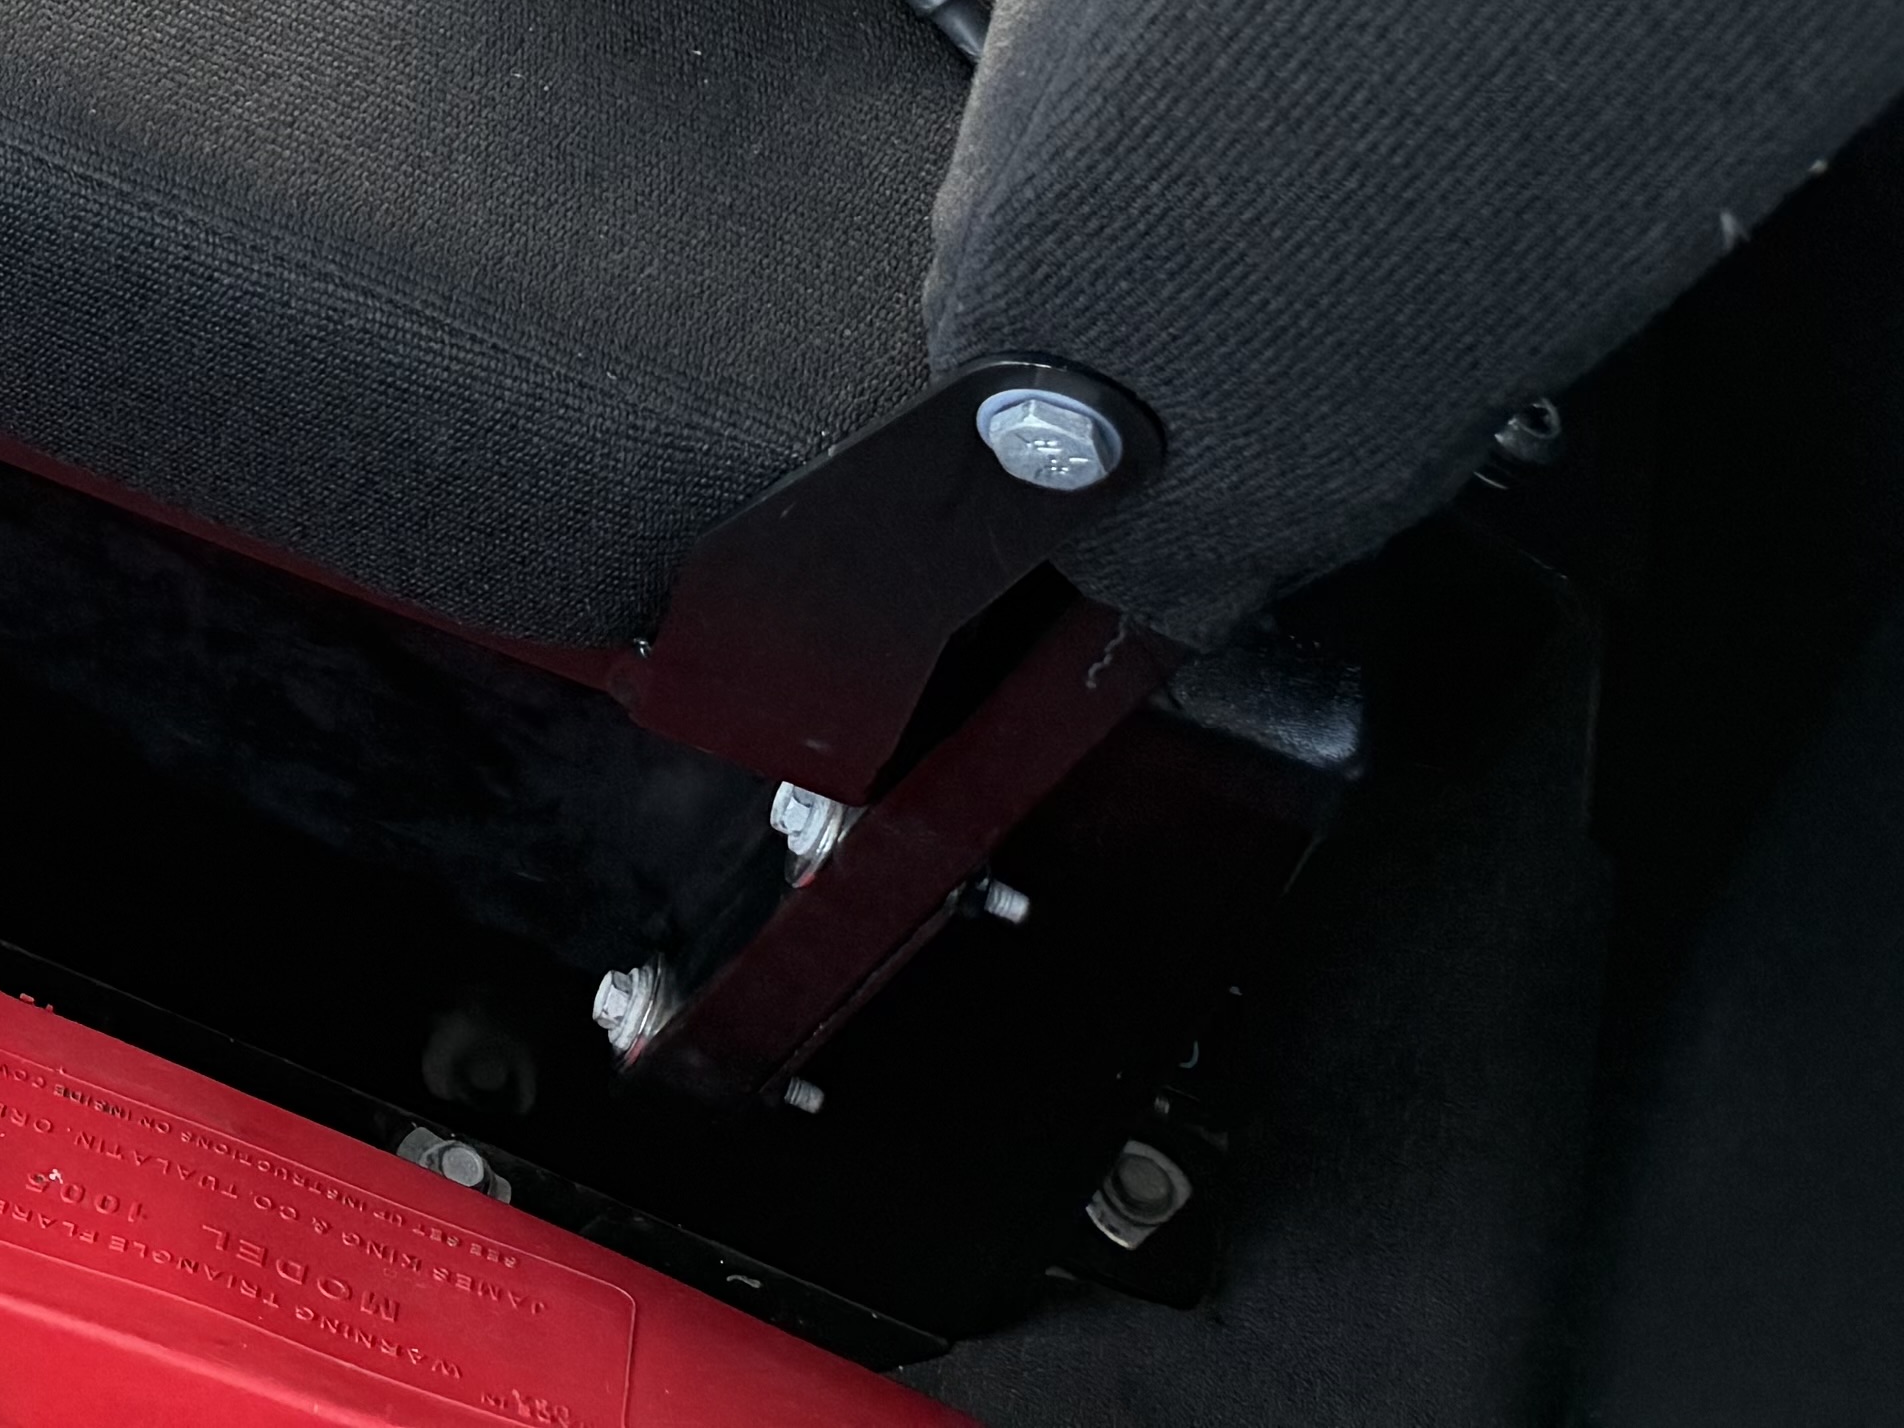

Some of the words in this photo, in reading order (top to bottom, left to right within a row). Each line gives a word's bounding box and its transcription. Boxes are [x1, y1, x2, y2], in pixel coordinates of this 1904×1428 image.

[53, 1082, 132, 1121] INSIDE
[24, 1168, 144, 1224] 1005
[180, 1130, 367, 1213] INSTRUCTIONS
[312, 1216, 333, 1235] &
[341, 1230, 422, 1272] KING
[412, 1222, 461, 1248] SET
[107, 1233, 280, 1309] TRIANGLE
[200, 1223, 402, 1323] MODEL
[431, 1266, 547, 1315] JAMES
[294, 1304, 463, 1379] WARNING
